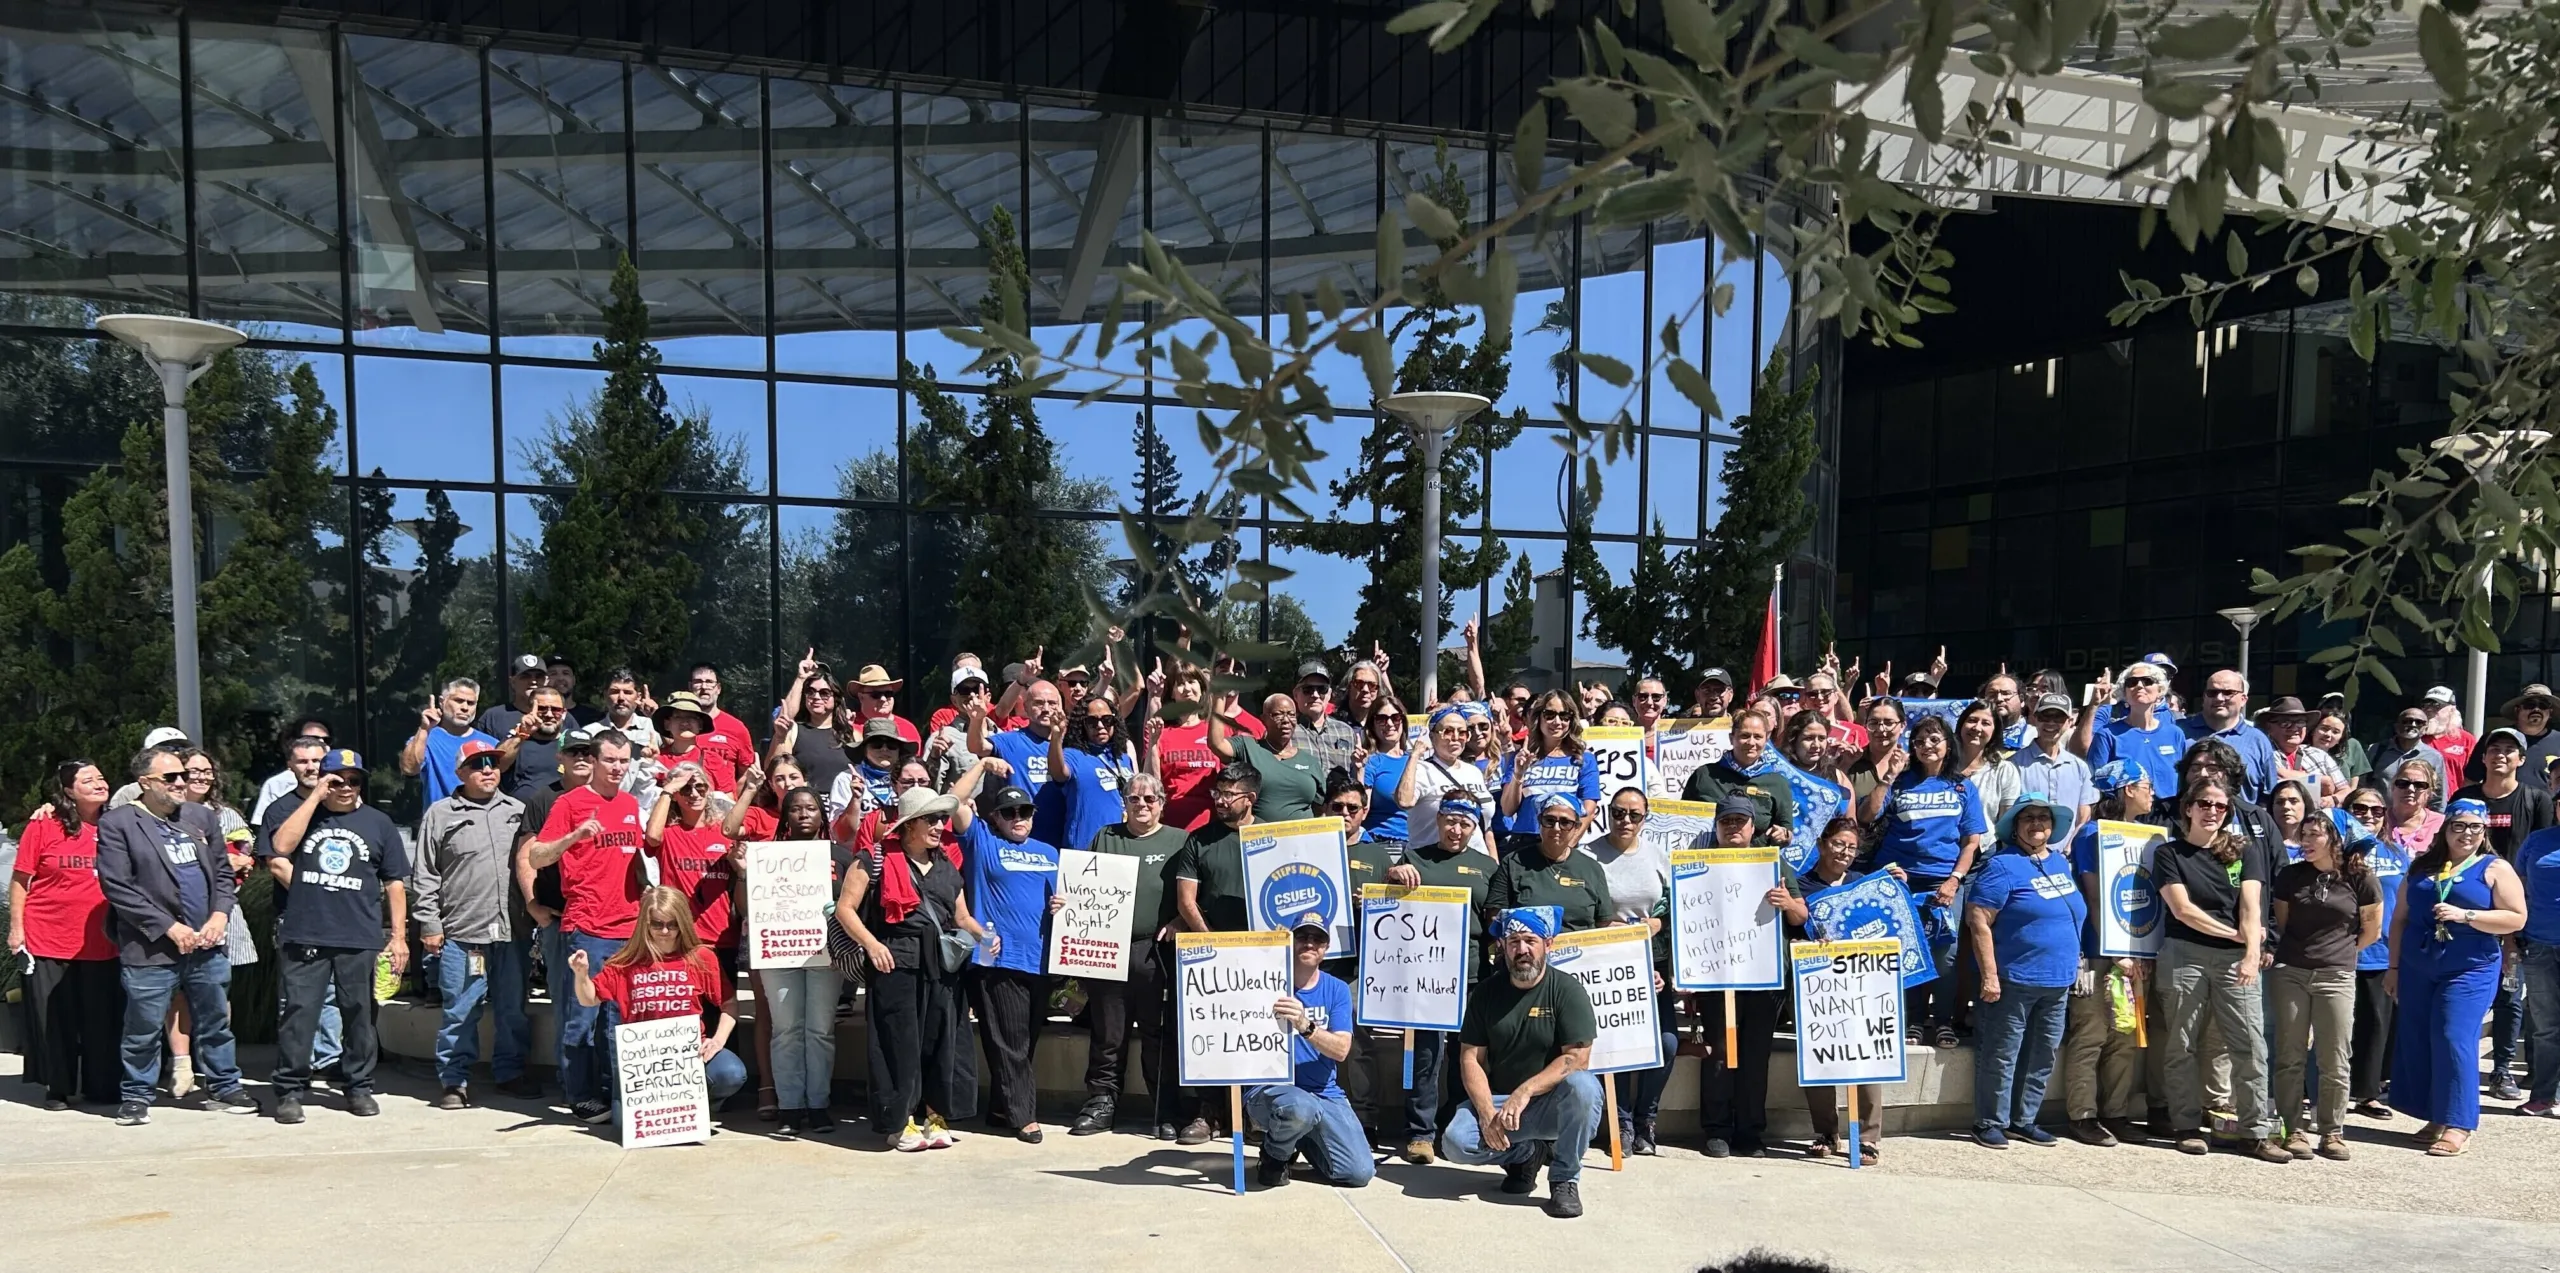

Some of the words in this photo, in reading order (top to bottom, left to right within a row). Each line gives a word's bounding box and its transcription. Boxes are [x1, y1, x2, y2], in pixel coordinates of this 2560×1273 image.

[2065, 640, 2224, 670] DREMS
[1690, 733, 1717, 745] WE
[1662, 748, 1710, 762] ALWAYS
[1591, 747, 1637, 781] EPS
[1244, 836, 1273, 848] CSUEU
[755, 846, 807, 874] Fund
[1082, 855, 1098, 876] A
[1674, 861, 1705, 872] CSUEU
[1272, 864, 1297, 881] STEPS
[1300, 864, 1319, 878] NOW
[302, 871, 319, 883] NO
[319, 872, 362, 891] PEACE!
[1063, 873, 1096, 903] living
[2030, 873, 2069, 889] CSUEU
[752, 884, 825, 900] CLASSROOM
[1274, 887, 1316, 906] CSUEU
[1681, 890, 1714, 912] Keep
[1725, 883, 1742, 898] up
[2121, 889, 2146, 901] CSUEU
[1365, 897, 1396, 905] CSUEU
[761, 929, 822, 938] CALIFORNIA
[1374, 913, 1438, 941] CSU
[1851, 918, 1883, 939] CSUEU
[762, 938, 822, 949] FACULTY
[1062, 936, 1119, 948] CALIFORNIA
[762, 950, 822, 959] ASSOCIATION
[1061, 946, 1118, 959] FACULTY
[1180, 945, 1213, 957] CSUEU
[1548, 945, 1578, 958] CSUEU
[1059, 956, 1117, 969] ASSOCIATION
[1798, 955, 1828, 966] CSUEU
[1832, 952, 1900, 975] STRIKE
[634, 970, 688, 985] RIGHTS
[1606, 966, 1636, 982] JOB
[631, 985, 695, 1000] RESPECT
[1365, 976, 1386, 1002] Pay
[1393, 985, 1408, 993] me
[1417, 977, 1457, 995] Mildred
[1804, 974, 1866, 996] DON'T
[1592, 990, 1622, 1006] ULD
[1627, 987, 1647, 1002] BE
[631, 1000, 691, 1014] JUSTICE
[1190, 1003, 1205, 1021] is
[1211, 1003, 1238, 1021] the
[1240, 1006, 1284, 1024] produc
[1809, 995, 1867, 1018] WANT
[1598, 1010, 1645, 1029] UGH!!!
[622, 1027, 650, 1043] Our
[655, 1022, 699, 1043] working
[1807, 1018, 1850, 1041] BUT
[1866, 1016, 1895, 1036] WE
[1192, 1034, 1215, 1055] OF
[1223, 1032, 1290, 1054] LABOR
[622, 1044, 679, 1062] conditions
[682, 1043, 700, 1053] are
[622, 1056, 699, 1080] STUDENT
[625, 1069, 704, 1094] LEARNING
[634, 1104, 697, 1119] CALIFORNIA
[635, 1114, 697, 1129] FACULTY
[634, 1125, 697, 1139] ASSOCIATION
